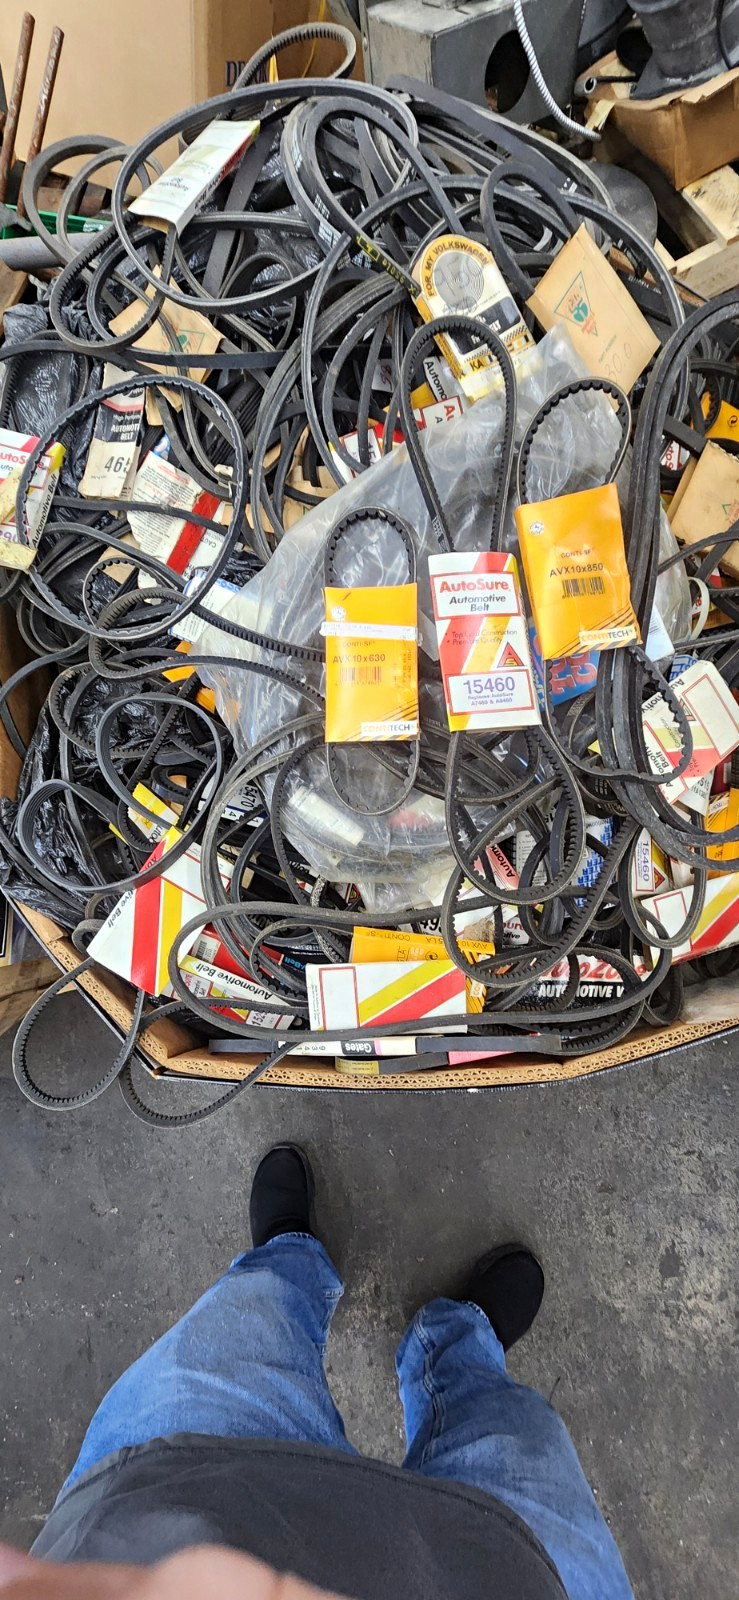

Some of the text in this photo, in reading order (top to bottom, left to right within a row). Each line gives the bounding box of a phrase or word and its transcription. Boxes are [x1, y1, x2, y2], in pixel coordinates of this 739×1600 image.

[424, 240, 490, 297] FOR MY VOLKSWAGEN
[120, 431, 135, 441] BELT
[31, 473, 58, 546] Automotive Belt
[550, 562, 604, 577] AVX10x850
[439, 578, 509, 593] AutoSure
[449, 595, 506, 605] Automotive
[470, 603, 490, 612] Belt
[452, 631, 463, 639] Top
[580, 628, 629, 643] CONTITECH
[463, 676, 515, 695] 15460
[655, 751, 670, 769] Belt
[642, 841, 650, 881] 15460
[107, 909, 122, 928] Belt
[196, 963, 217, 977] Belt
[216, 972, 273, 1001] Automotive
[345, 1042, 372, 1053] Gates
